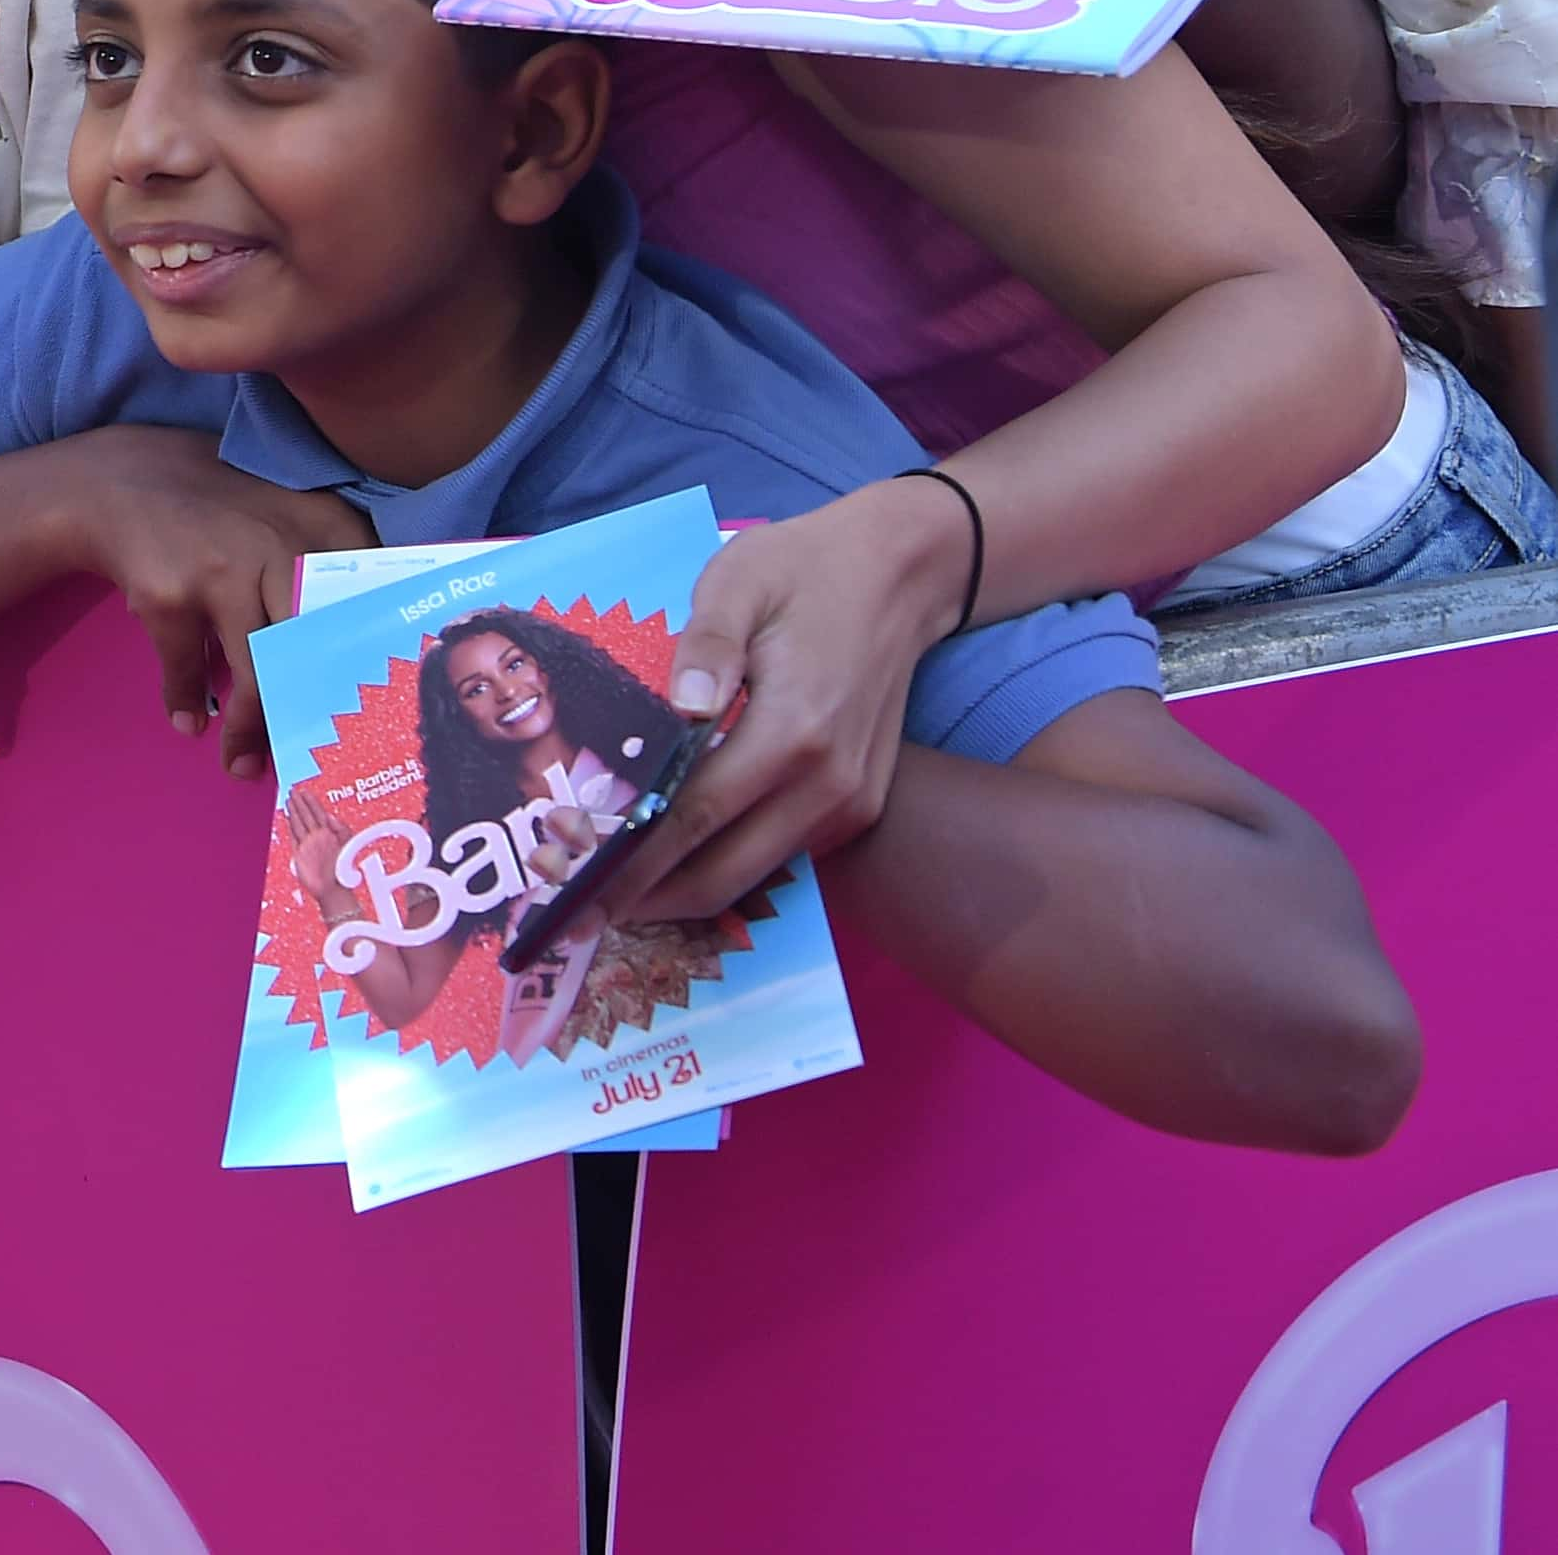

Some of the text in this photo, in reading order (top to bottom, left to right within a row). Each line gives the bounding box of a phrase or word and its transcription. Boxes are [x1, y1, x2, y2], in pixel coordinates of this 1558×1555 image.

[399, 571, 498, 624] Issa Rae
[326, 785, 355, 804] This
[355, 764, 404, 792] Barbie
[322, 756, 632, 976] Barb
[581, 1033, 690, 1083] In cinemas
[592, 1071, 662, 1115] July
[663, 1049, 703, 1086] 21
